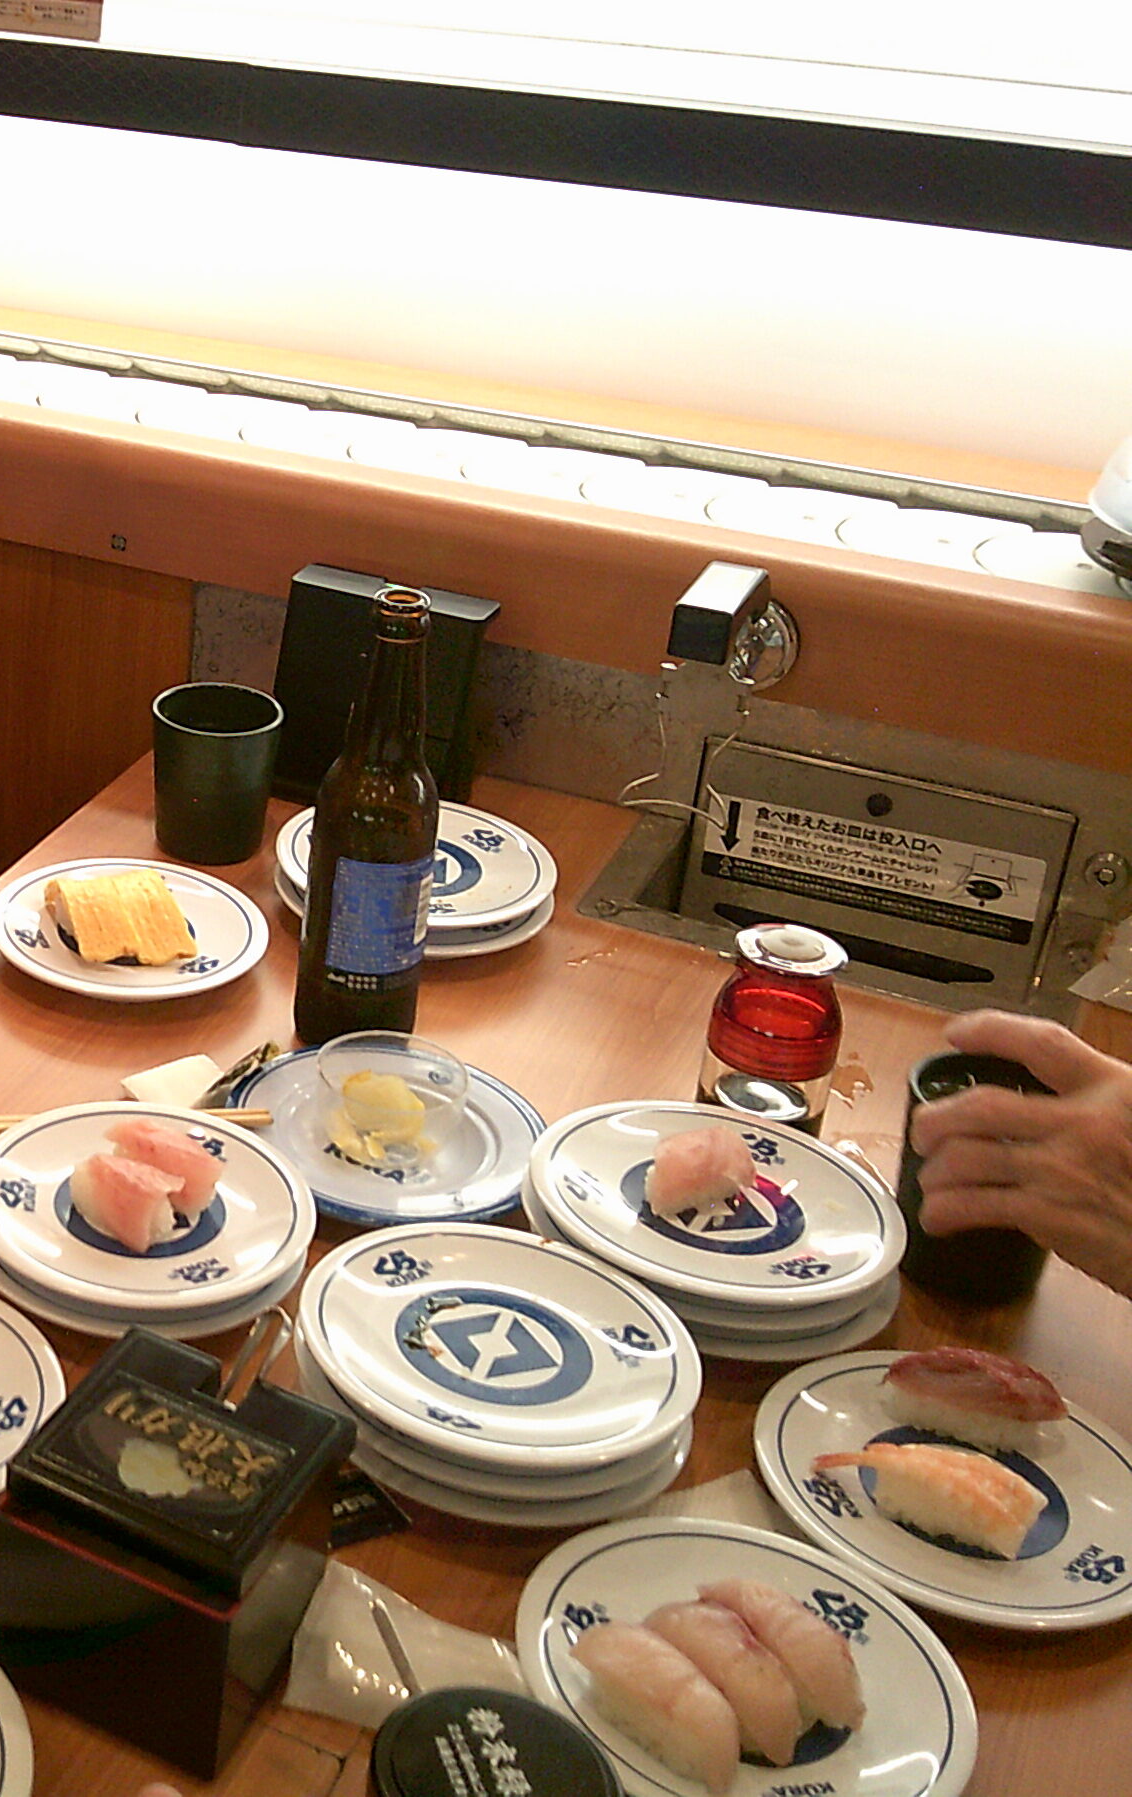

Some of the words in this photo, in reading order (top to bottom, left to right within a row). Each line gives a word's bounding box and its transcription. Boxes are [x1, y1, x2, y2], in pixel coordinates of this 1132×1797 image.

[755, 806, 943, 855] 食べ終えたお皿は投入口へ
